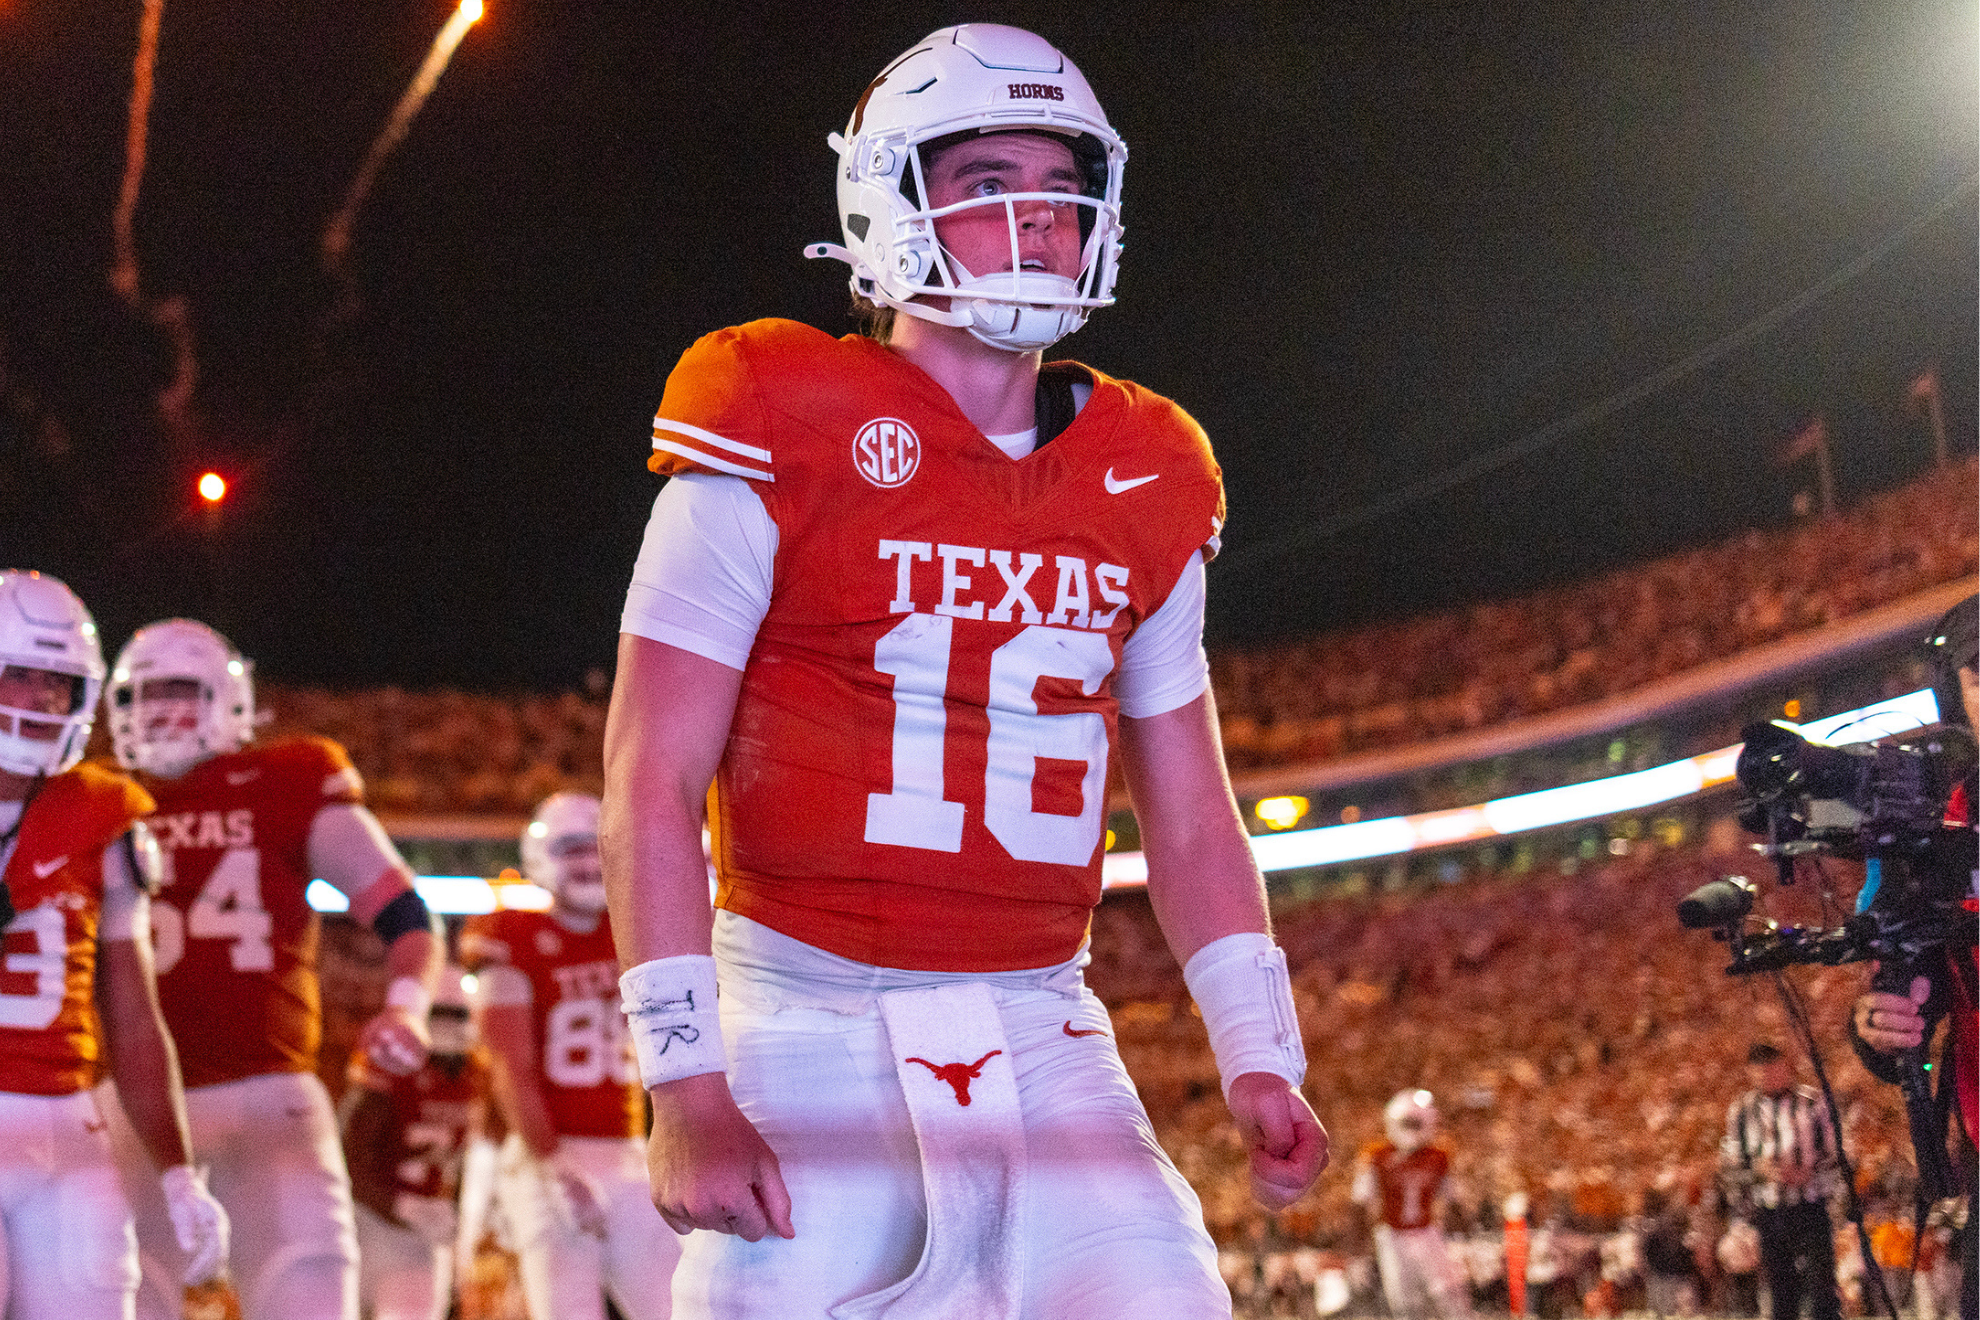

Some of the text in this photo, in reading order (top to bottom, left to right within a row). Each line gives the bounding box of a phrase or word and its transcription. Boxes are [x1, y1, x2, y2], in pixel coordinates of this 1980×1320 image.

[1007, 83, 1064, 102] HORNS
[859, 422, 914, 483] SEC
[878, 539, 1130, 629] TEXAS
[864, 611, 1115, 867] 16
[151, 809, 254, 850] XAS
